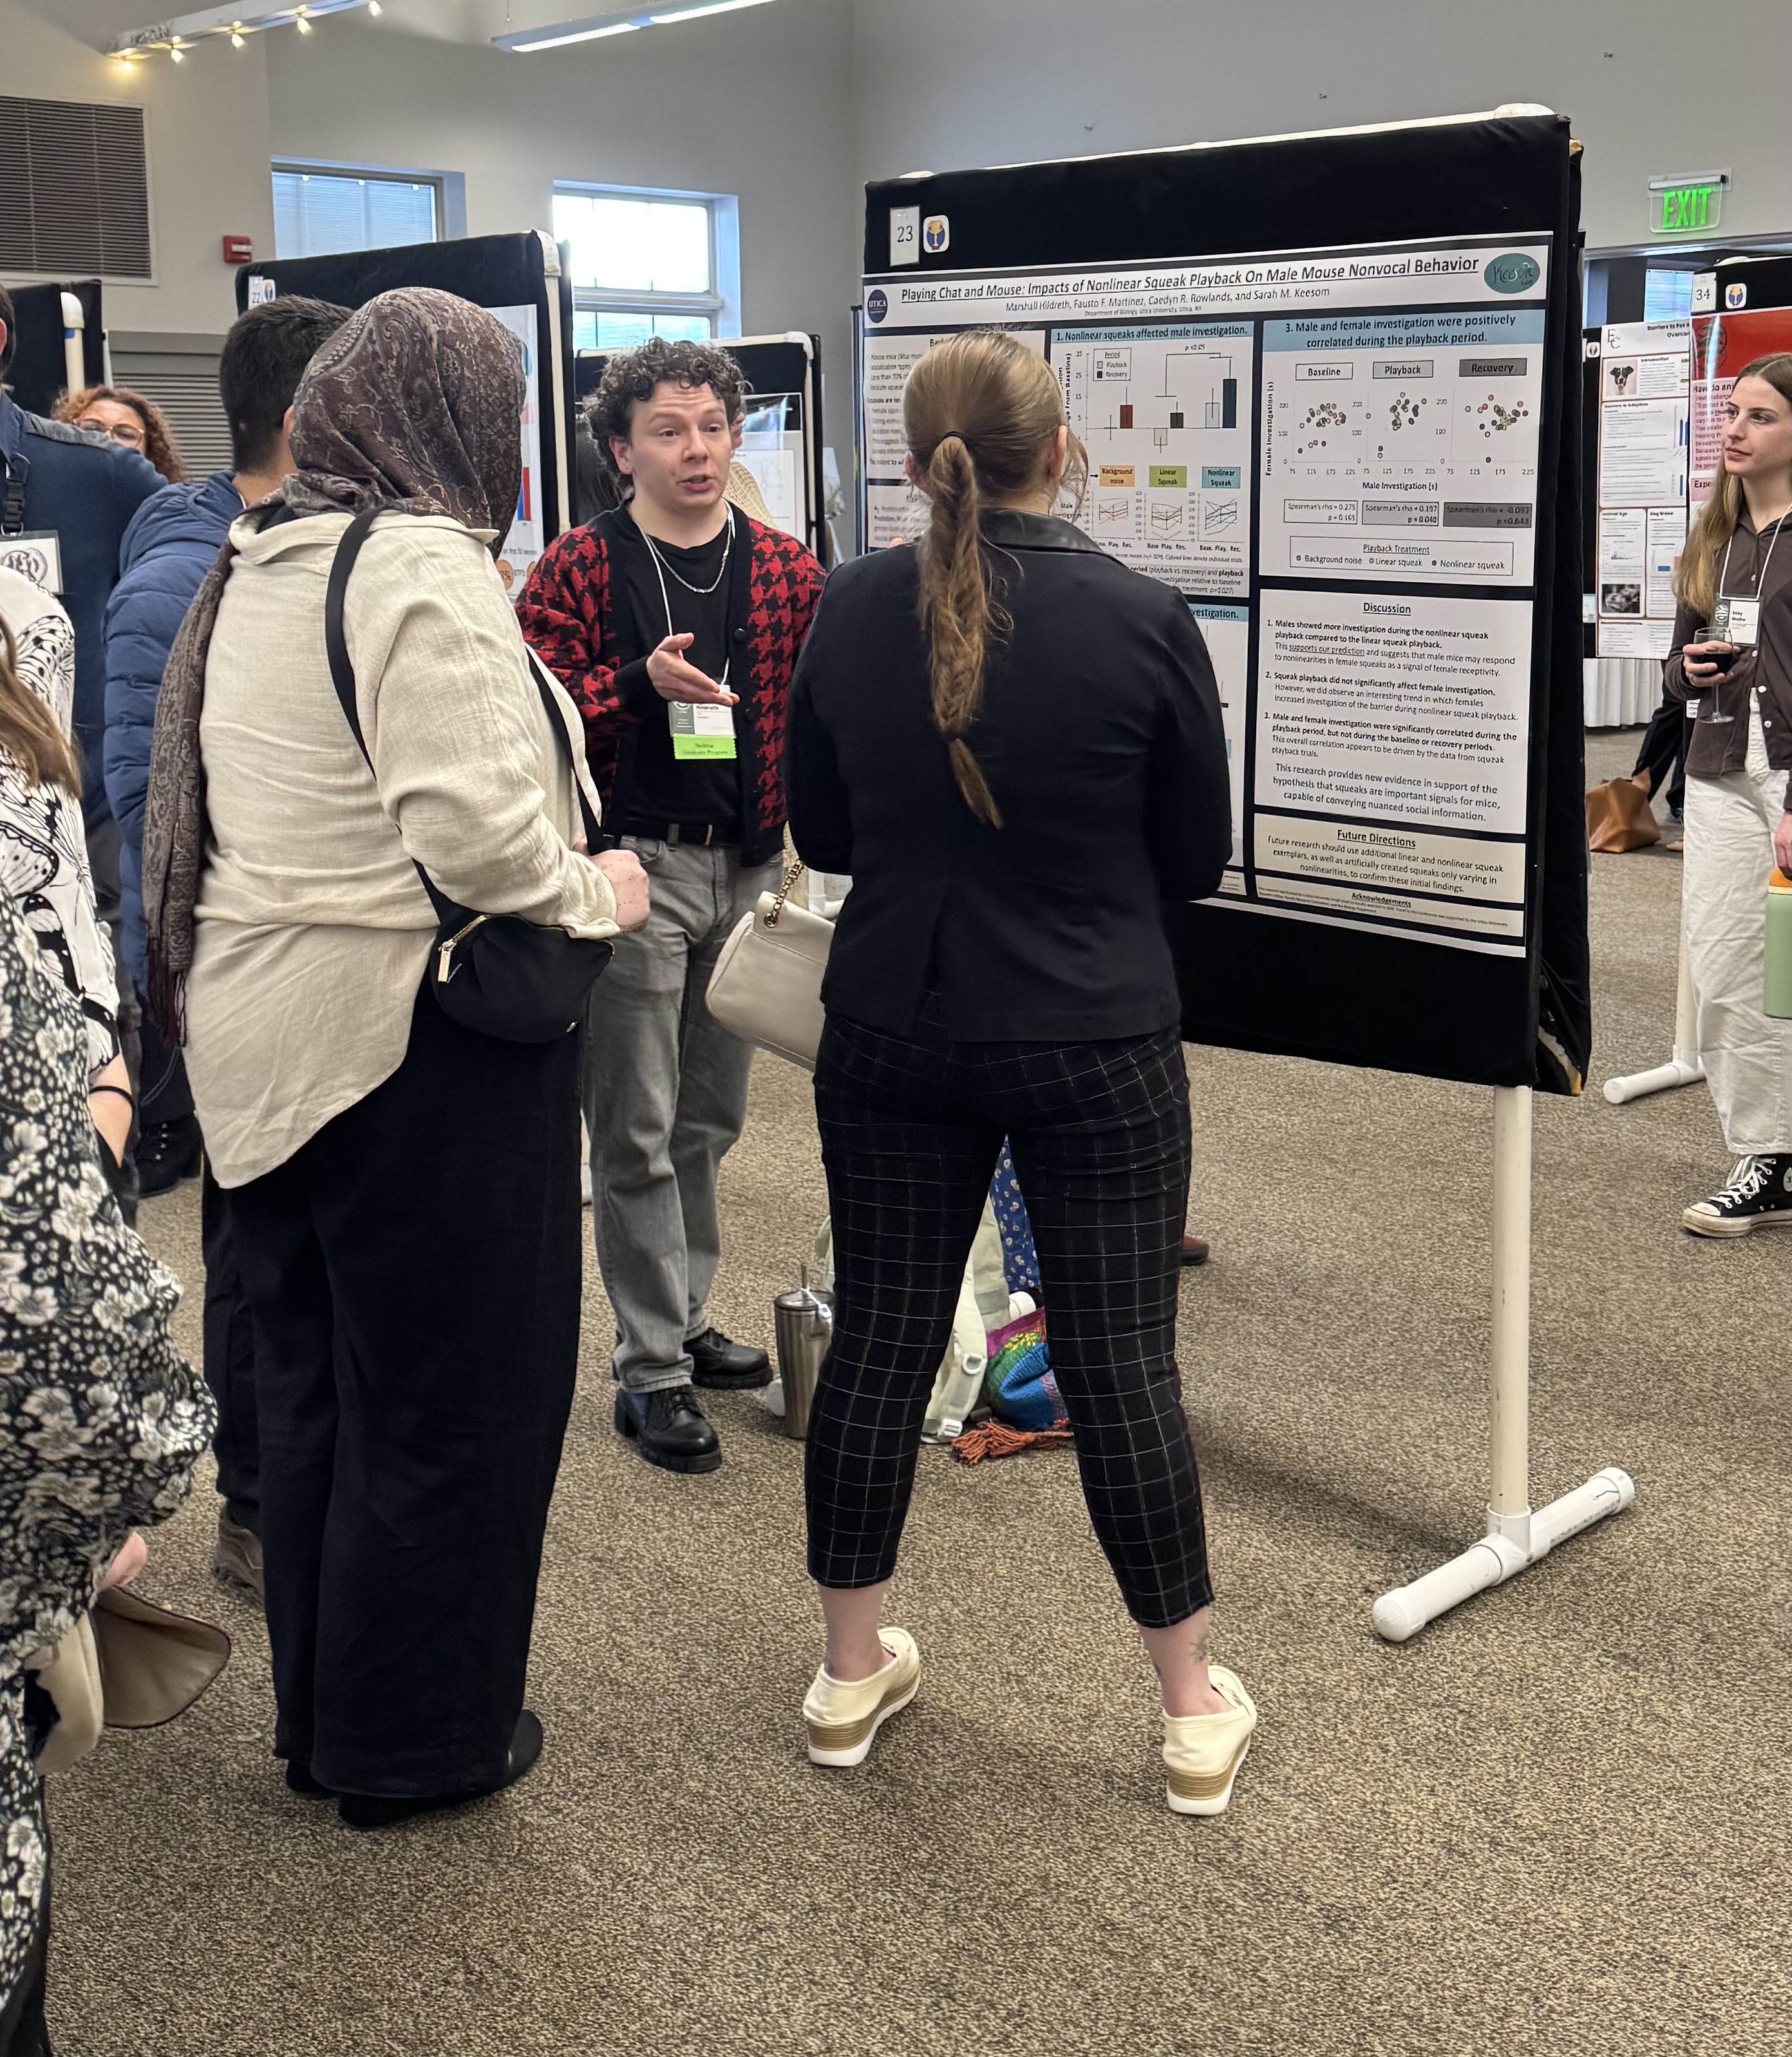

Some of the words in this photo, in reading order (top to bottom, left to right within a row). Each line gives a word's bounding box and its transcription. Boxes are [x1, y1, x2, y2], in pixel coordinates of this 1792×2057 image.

[1662, 188, 1712, 229] EXIT
[897, 225, 913, 243] 23
[903, 287, 936, 303] Playing
[939, 286, 961, 299] Chat
[965, 285, 983, 298] and
[987, 283, 1024, 296] Mouse:
[1028, 280, 1069, 297] Impacts
[1073, 280, 1084, 292] of
[1087, 276, 1141, 291] Nonlinear
[1145, 274, 1185, 291] Squeak
[1190, 271, 1241, 289] Playback
[1246, 270, 1262, 283] On
[1267, 268, 1297, 281] Male
[1302, 265, 1344, 280] Mouse
[1349, 262, 1410, 278] Nonvocal
[1415, 258, 1479, 274] Behavior
[252, 292, 260, 304] 22
[1006, 301, 1037, 312] Marshall
[1040, 299, 1071, 312] Hildreth,
[1075, 298, 1099, 308] Fausto
[1109, 296, 1145, 308] Martinez,
[1149, 294, 1178, 307] Caedyn
[1181, 294, 1188, 303] R.
[1191, 292, 1232, 305] Rowlands,
[1236, 290, 1251, 301] and
[1254, 289, 1277, 300] Sarah
[1281, 289, 1292, 299] M.
[1295, 287, 1330, 298] Keesom
[1696, 289, 1710, 301] 34
[869, 299, 887, 308] UTICA
[1285, 323, 1292, 333] 3.
[1296, 323, 1317, 332] Male
[1321, 322, 1337, 332] and
[1341, 321, 1371, 331] female
[1374, 319, 1434, 332] investigation
[1466, 316, 1516, 329] positively
[1057, 331, 1063, 341] 1.
[1066, 330, 1101, 341] Nonlinear
[1104, 329, 1134, 341] squeaks
[1137, 328, 1168, 338] affected
[1171, 327, 1190, 337] male
[1193, 325, 1248, 338] investigation.
[1306, 337, 1352, 348] correlated
[1355, 336, 1384, 348] during
[1388, 336, 1402, 346] the
[1406, 334, 1448, 347] playback
[1451, 333, 1487, 345] period.
[1308, 368, 1341, 376] Baseline
[1384, 365, 1421, 376] Playback
[1471, 363, 1514, 375] Recovery
[1102, 467, 1133, 477] Background
[1363, 481, 1379, 489] Male
[1382, 481, 1426, 491] Investigation
[1429, 482, 1438, 492] (s)
[1364, 544, 1392, 555] Playback
[1395, 545, 1430, 554] Treatment
[1305, 555, 1343, 565] Background
[1344, 556, 1362, 564] noise
[1376, 558, 1395, 566] Linear
[1399, 558, 1422, 568] squeak
[1441, 559, 1475, 569] Nonlinear
[1478, 560, 1505, 572] squeak
[1192, 607, 1239, 619] estigation.
[1363, 603, 1411, 614] Discussion
[1276, 620, 1294, 628] Males
[1297, 621, 1322, 630] showed
[1343, 623, 1386, 634] investigation
[1388, 626, 1410, 636] during
[1426, 629, 1459, 638] nonlinear
[1462, 630, 1489, 641] squeak
[1276, 631, 1303, 641] playback
[1305, 632, 1338, 643] compared
[1362, 636, 1380, 645] linear
[1383, 638, 1407, 647] squeak
[1410, 640, 1442, 650] playback.
[1276, 642, 1287, 650] This
[1290, 643, 1317, 654] supports
[1332, 645, 1364, 656] prediction
[1366, 648, 1379, 656] and
[1381, 649, 1409, 659] suggests
[1411, 650, 1425, 659] that
[1428, 652, 1444, 660] male
[1446, 653, 1463, 661] mice
[1466, 656, 1480, 664] may
[1483, 655, 1515, 666] respond
[1276, 763, 1291, 773] This
[1294, 764, 1326, 777] research
[1328, 768, 1363, 782] provides
[1365, 774, 1382, 782] new
[1385, 774, 1421, 786] evidence
[1424, 778, 1431, 787] in
[1435, 779, 1467, 793] support
[1471, 782, 1479, 792] of
[1482, 784, 1498, 794] the
[1273, 776, 1314, 791] hypothesis
[1317, 781, 1332, 791] that
[1335, 782, 1367, 797] squeaks
[1385, 788, 1426, 802] important
[1429, 792, 1457, 806] signals
[1460, 795, 1472, 806] for
[1476, 797, 1501, 810] mice,
[1284, 791, 1314, 804] capable
[1316, 794, 1323, 804] of
[1326, 795, 1366, 810] conveying
[1368, 800, 1403, 812] nuanced
[1406, 804, 1429, 815] social
[1432, 806, 1486, 821] information.
[1338, 829, 1366, 842] Future
[1370, 833, 1416, 848] Directions
[1268, 835, 1289, 846] Future
[1292, 838, 1320, 849] research
[1323, 841, 1344, 853] should
[1361, 846, 1396, 859] additional
[1399, 851, 1419, 862] linear
[1422, 853, 1435, 864] and
[1437, 855, 1473, 868] nonlinear
[1475, 860, 1504, 874] squeak
[1351, 869, 1357, 878] to
[1360, 870, 1386, 882] confirm
[1389, 874, 1408, 885] these
[1411, 877, 1430, 887] initial
[1433, 880, 1464, 894] findings.
